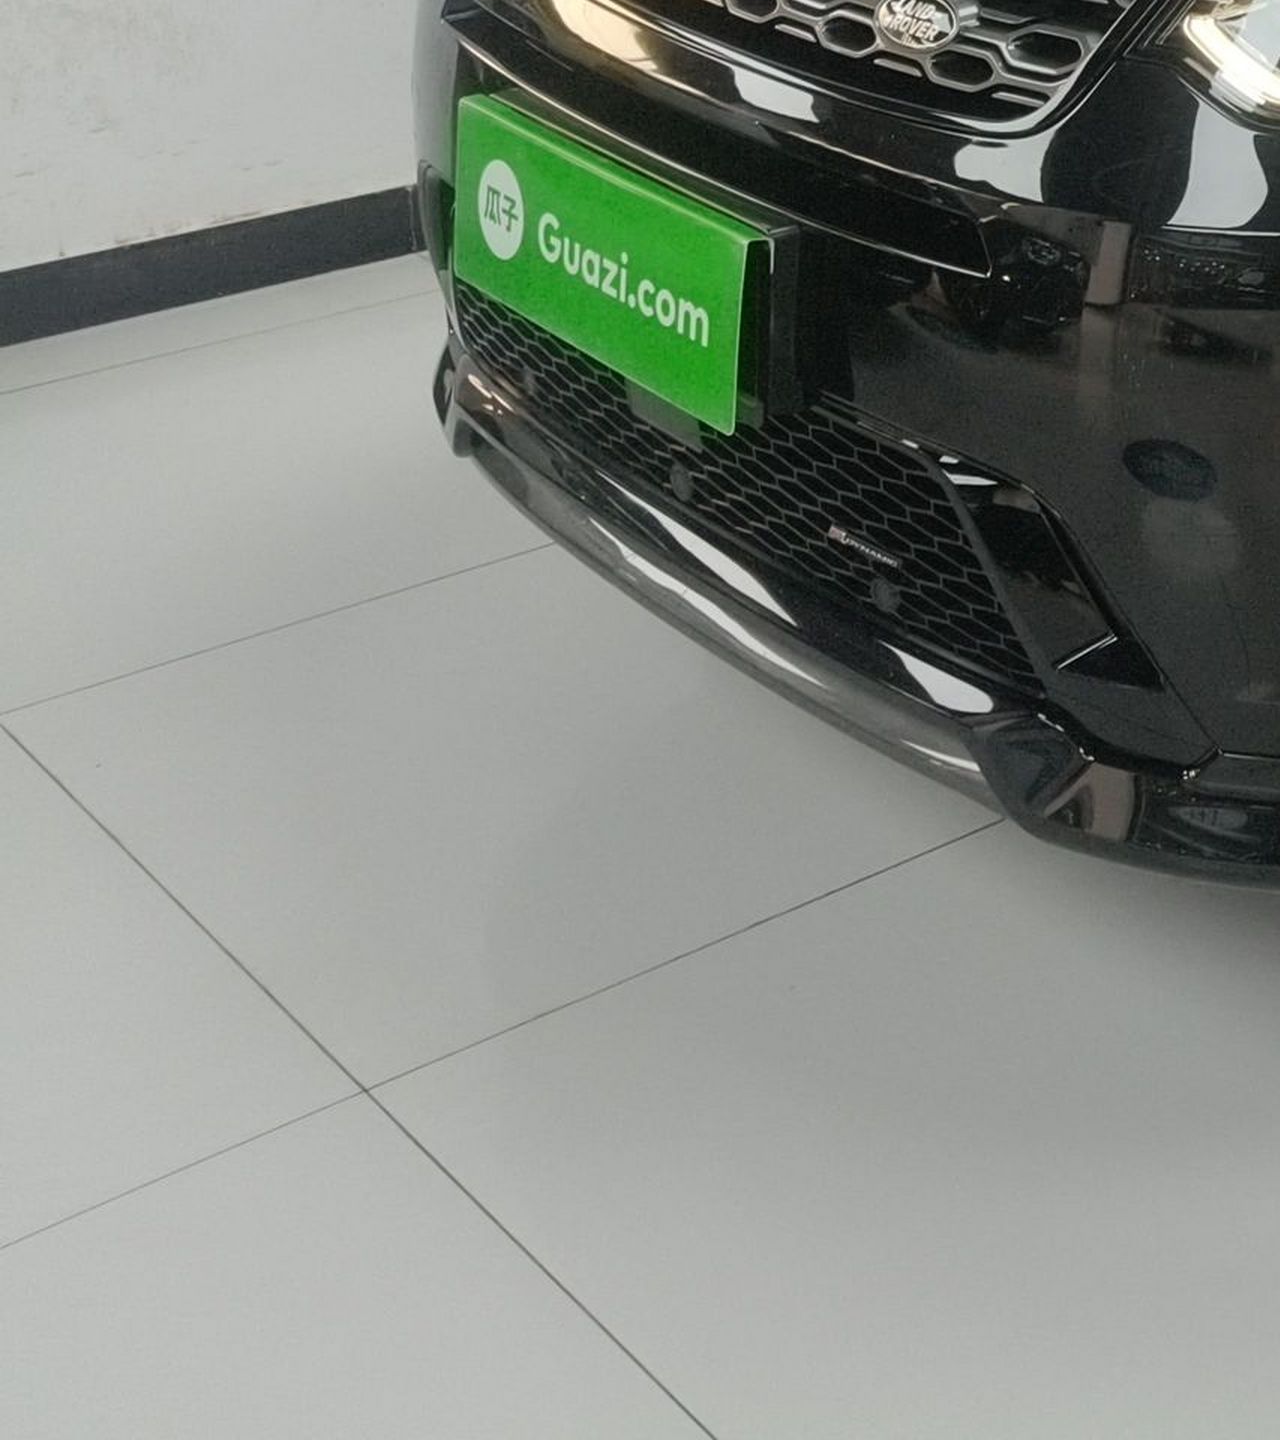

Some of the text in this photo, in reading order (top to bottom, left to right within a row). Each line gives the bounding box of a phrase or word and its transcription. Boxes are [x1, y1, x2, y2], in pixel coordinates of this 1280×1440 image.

[888, 13, 939, 41] ROVER
[484, 184, 519, 232] 瓜子
[538, 212, 709, 348] Guazi.com
